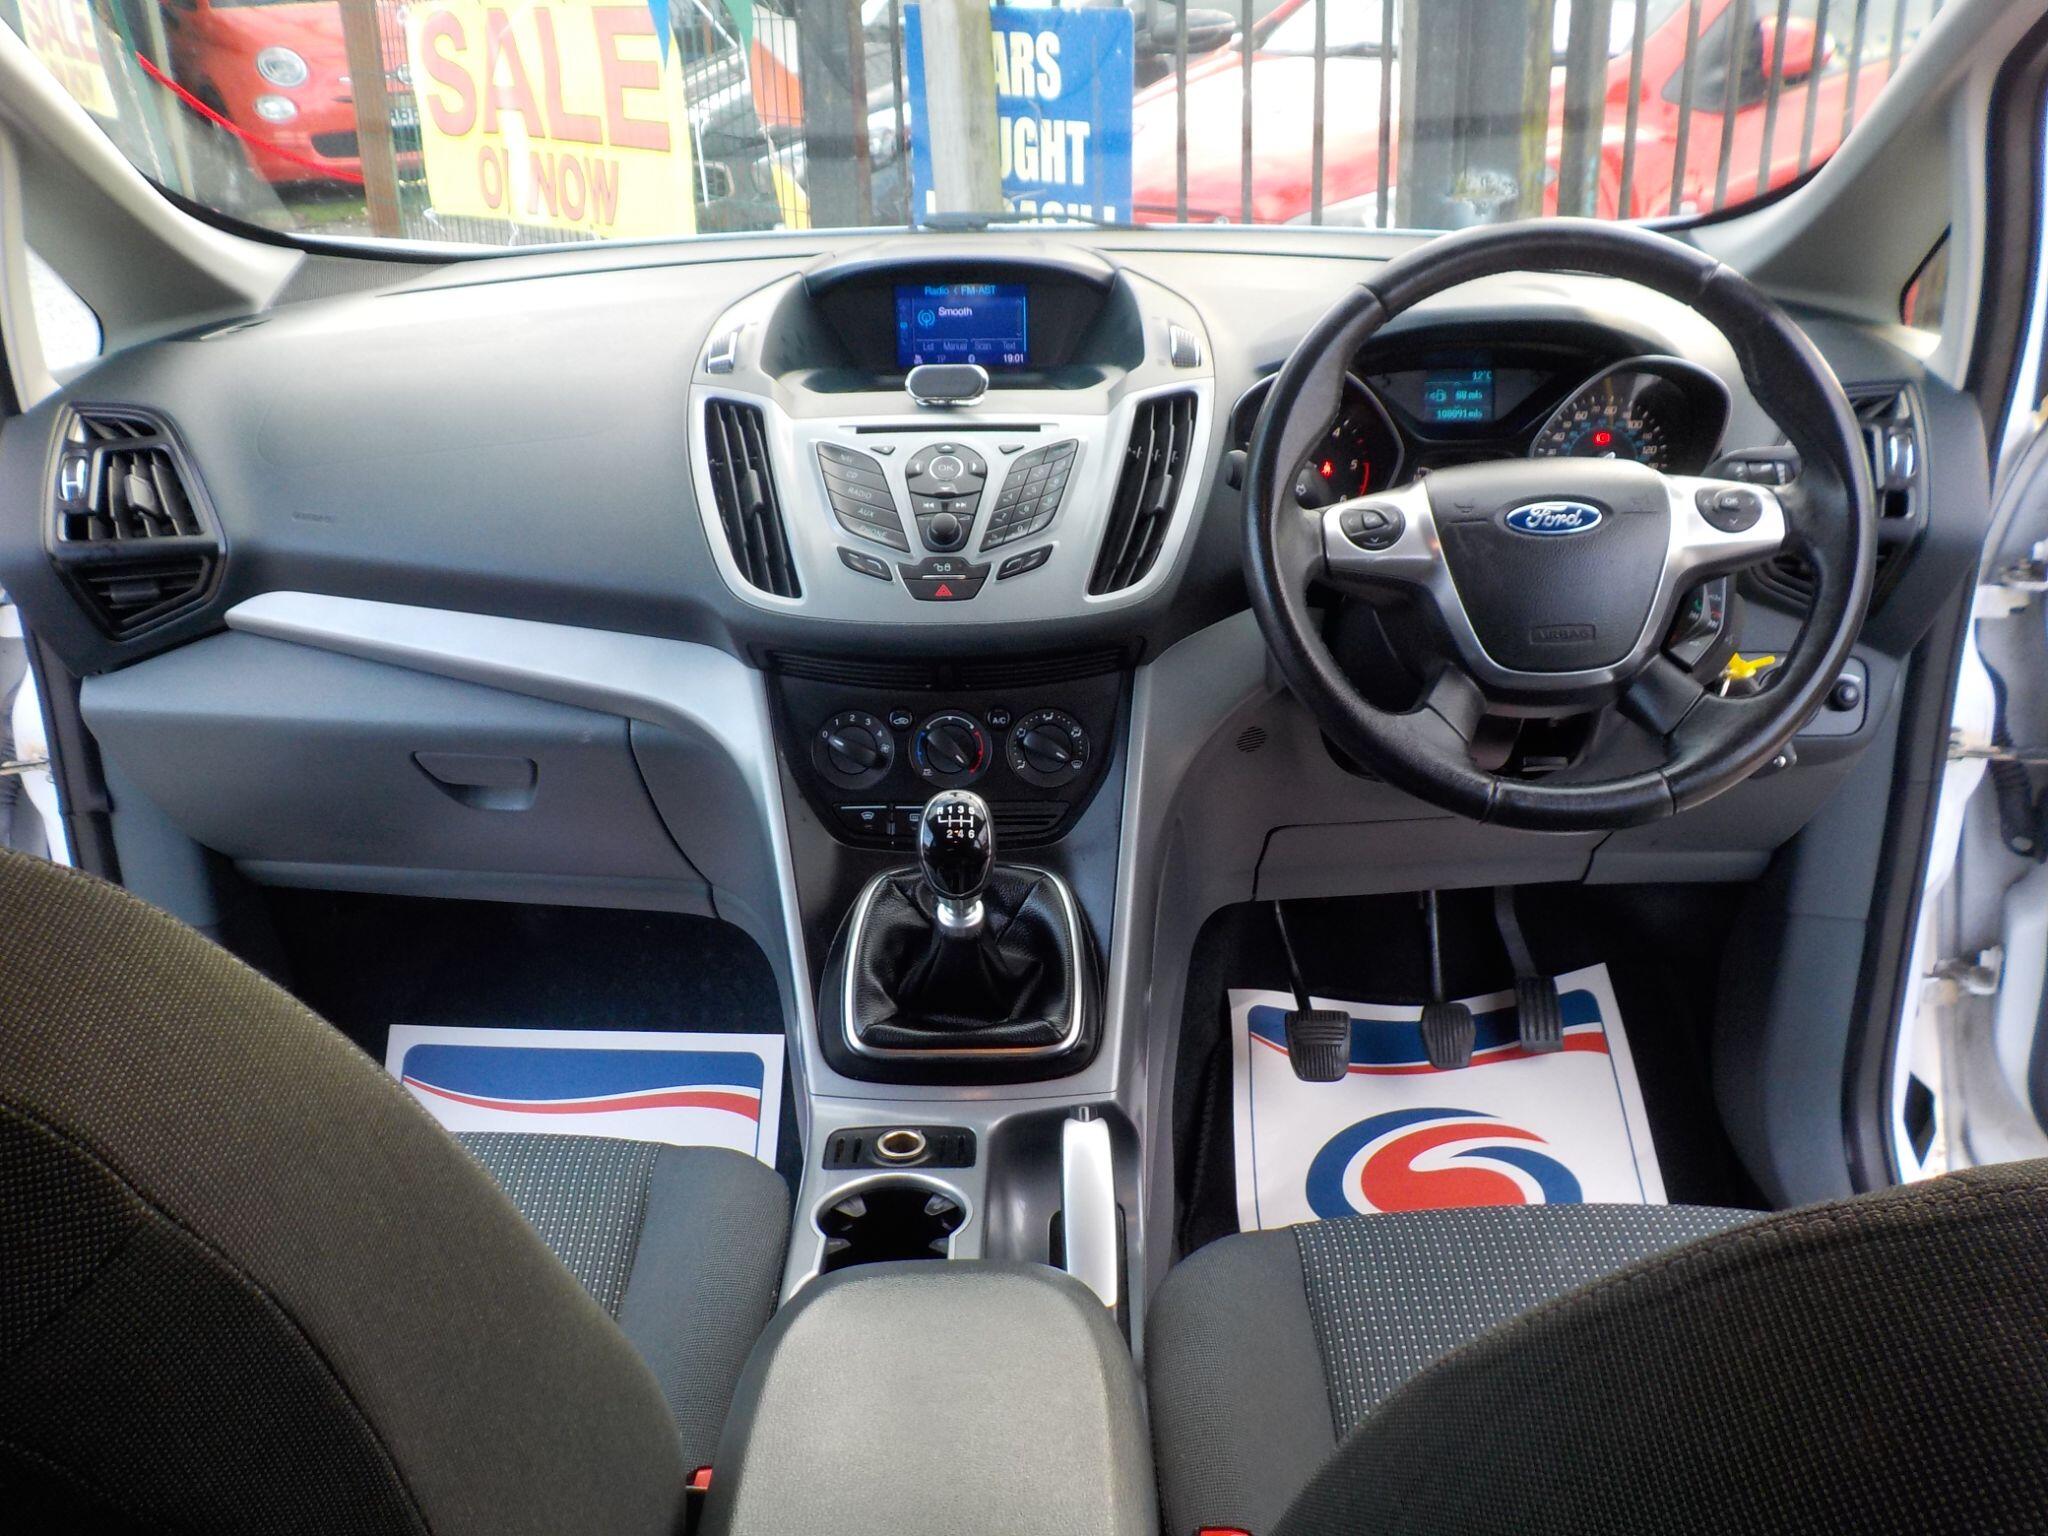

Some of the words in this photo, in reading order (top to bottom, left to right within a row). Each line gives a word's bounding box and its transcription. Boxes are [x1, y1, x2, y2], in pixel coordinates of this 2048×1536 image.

[992, 30, 1062, 100] ARS
[421, 6, 672, 153] SALE
[527, 151, 620, 228] NOW
[924, 285, 950, 296] Radio
[938, 307, 973, 317] Smooth
[943, 341, 968, 351] Manual
[974, 341, 992, 351] Scan
[1003, 340, 1016, 350] Text
[1003, 354, 1024, 363] 19:01
[1627, 420, 1643, 430] 100
[938, 464, 954, 472] OK
[846, 471, 858, 479] CD
[848, 487, 872, 499] RADIO
[858, 508, 874, 518] AUX
[1525, 504, 1583, 529] Ford
[1535, 628, 1591, 640] AIRBAG
[834, 718, 839, 726] 1
[850, 714, 856, 722] 2
[865, 718, 871, 726] 3
[992, 717, 1006, 725] A/C
[822, 730, 828, 738] 0
[877, 730, 882, 738] 4
[947, 805, 953, 814] 1
[957, 805, 964, 814] 3
[968, 806, 975, 815] 5
[946, 829, 953, 839] 2
[957, 829, 964, 839] 4
[968, 829, 975, 839] 6
